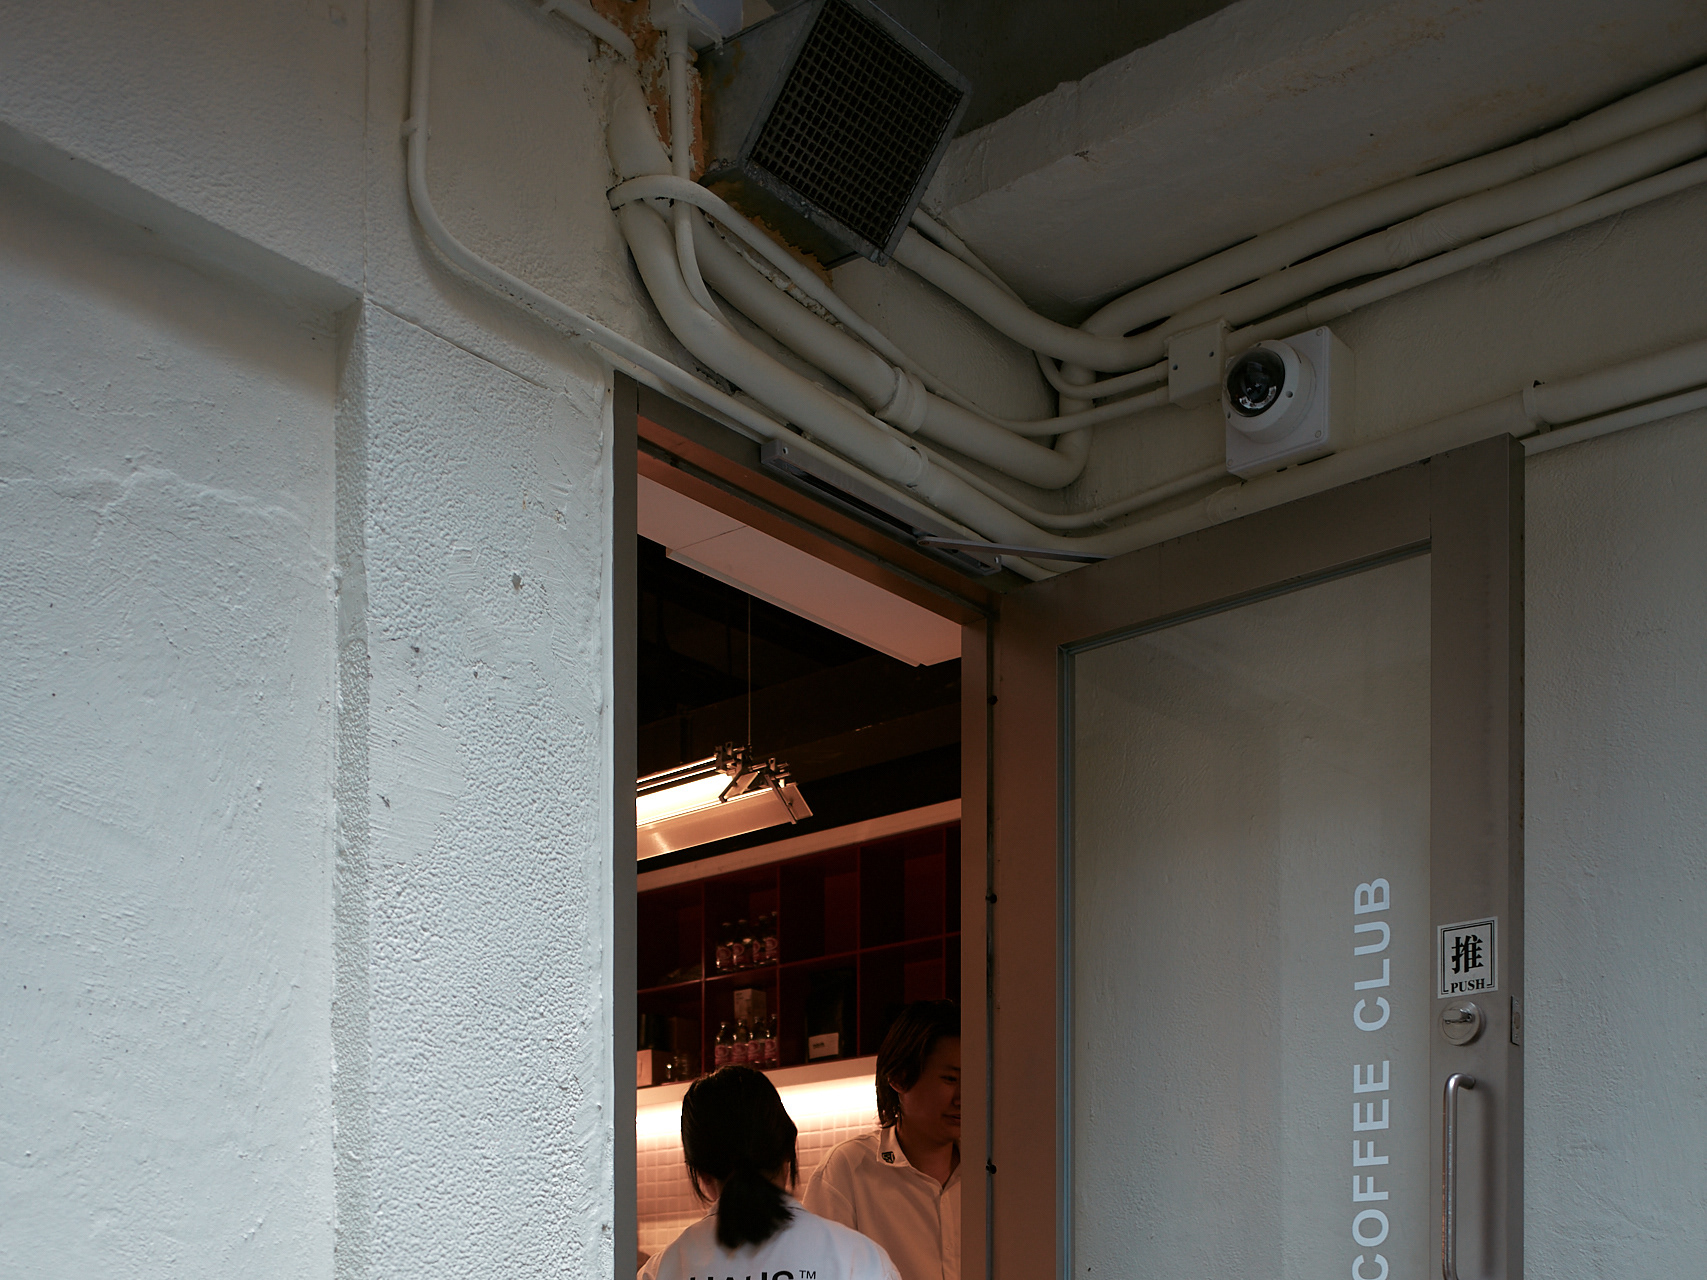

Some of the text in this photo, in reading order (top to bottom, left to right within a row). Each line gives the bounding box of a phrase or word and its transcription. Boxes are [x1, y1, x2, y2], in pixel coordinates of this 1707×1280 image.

[1352, 877, 1391, 1032] CLUB
[1451, 934, 1484, 974] 推
[1450, 978, 1485, 993] PUSH
